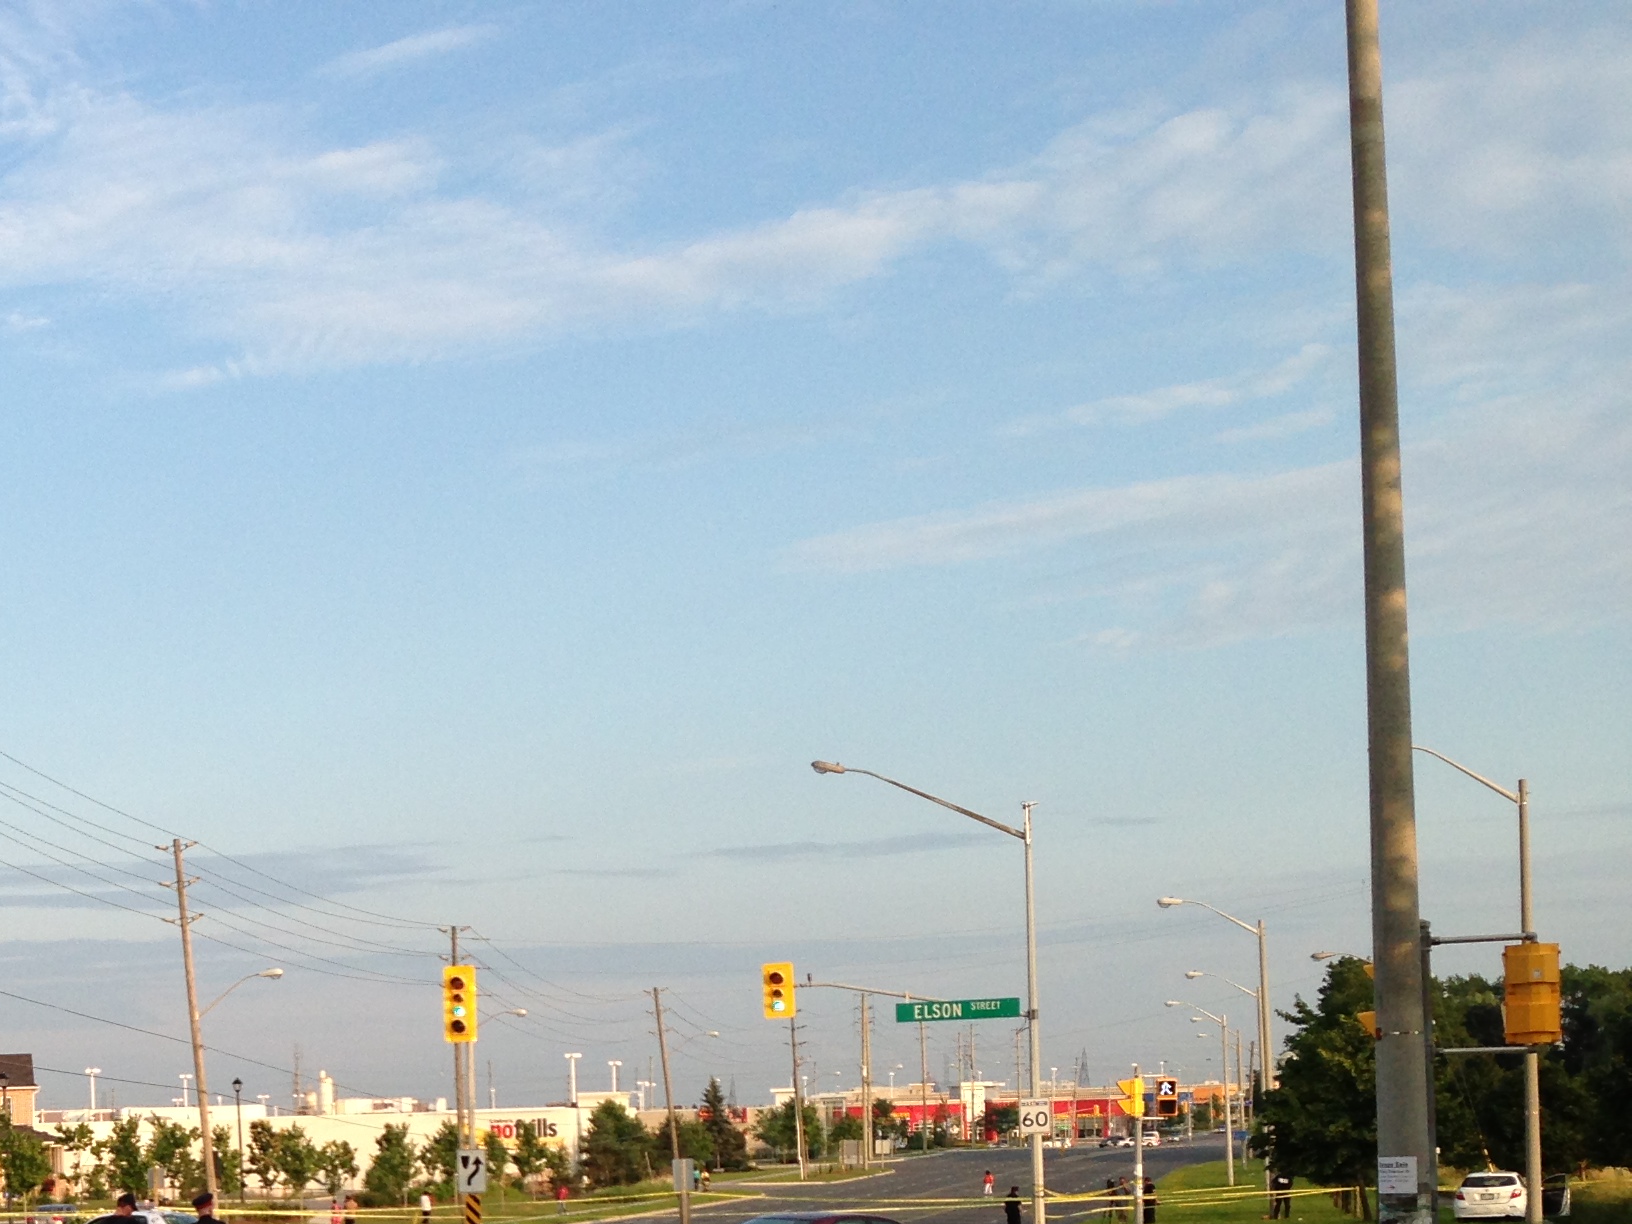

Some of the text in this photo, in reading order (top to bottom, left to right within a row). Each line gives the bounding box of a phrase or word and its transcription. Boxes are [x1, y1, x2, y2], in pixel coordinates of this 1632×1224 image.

[914, 1001, 1000, 1019] ELSON STREET
[1022, 1111, 1048, 1127] 60
